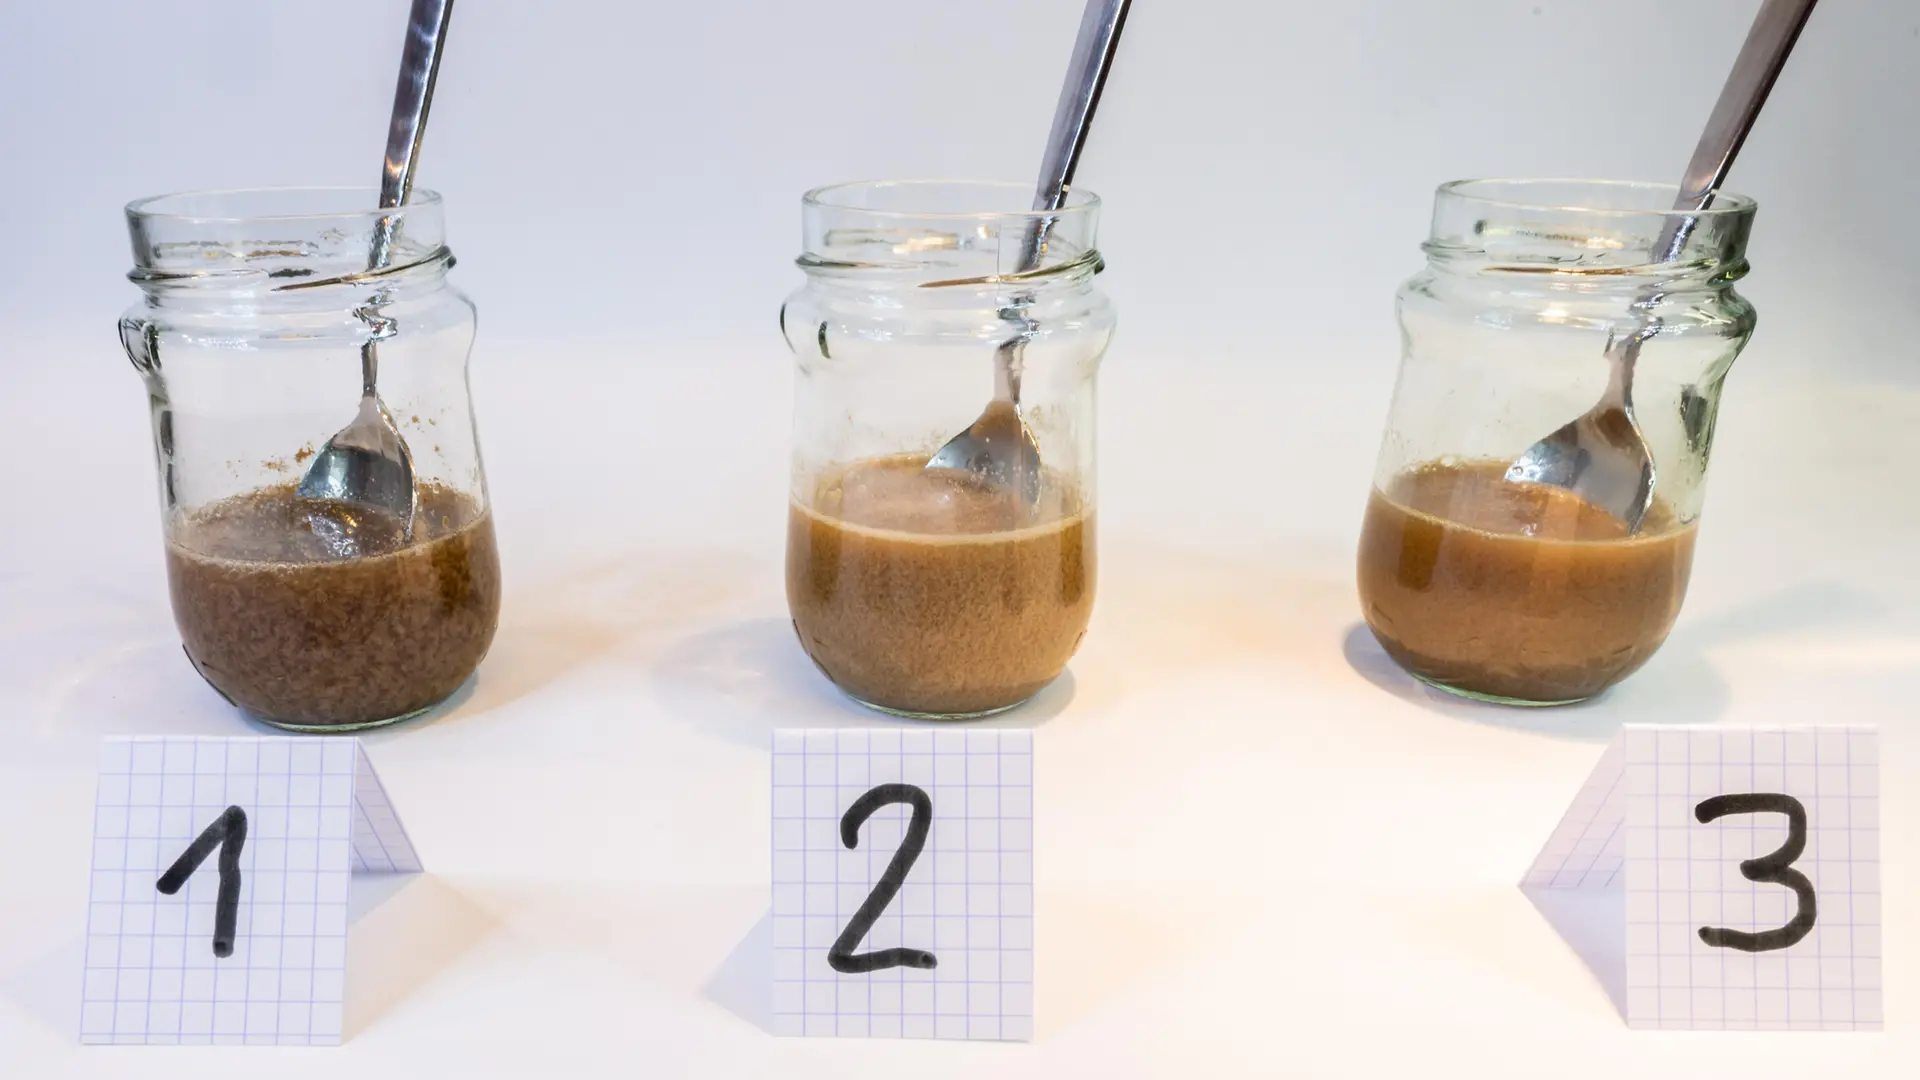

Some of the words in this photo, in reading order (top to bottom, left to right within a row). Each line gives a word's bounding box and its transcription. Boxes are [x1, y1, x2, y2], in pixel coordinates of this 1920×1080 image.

[156, 805, 247, 957] 1
[828, 783, 937, 973] 2
[1694, 793, 1817, 952] 3
